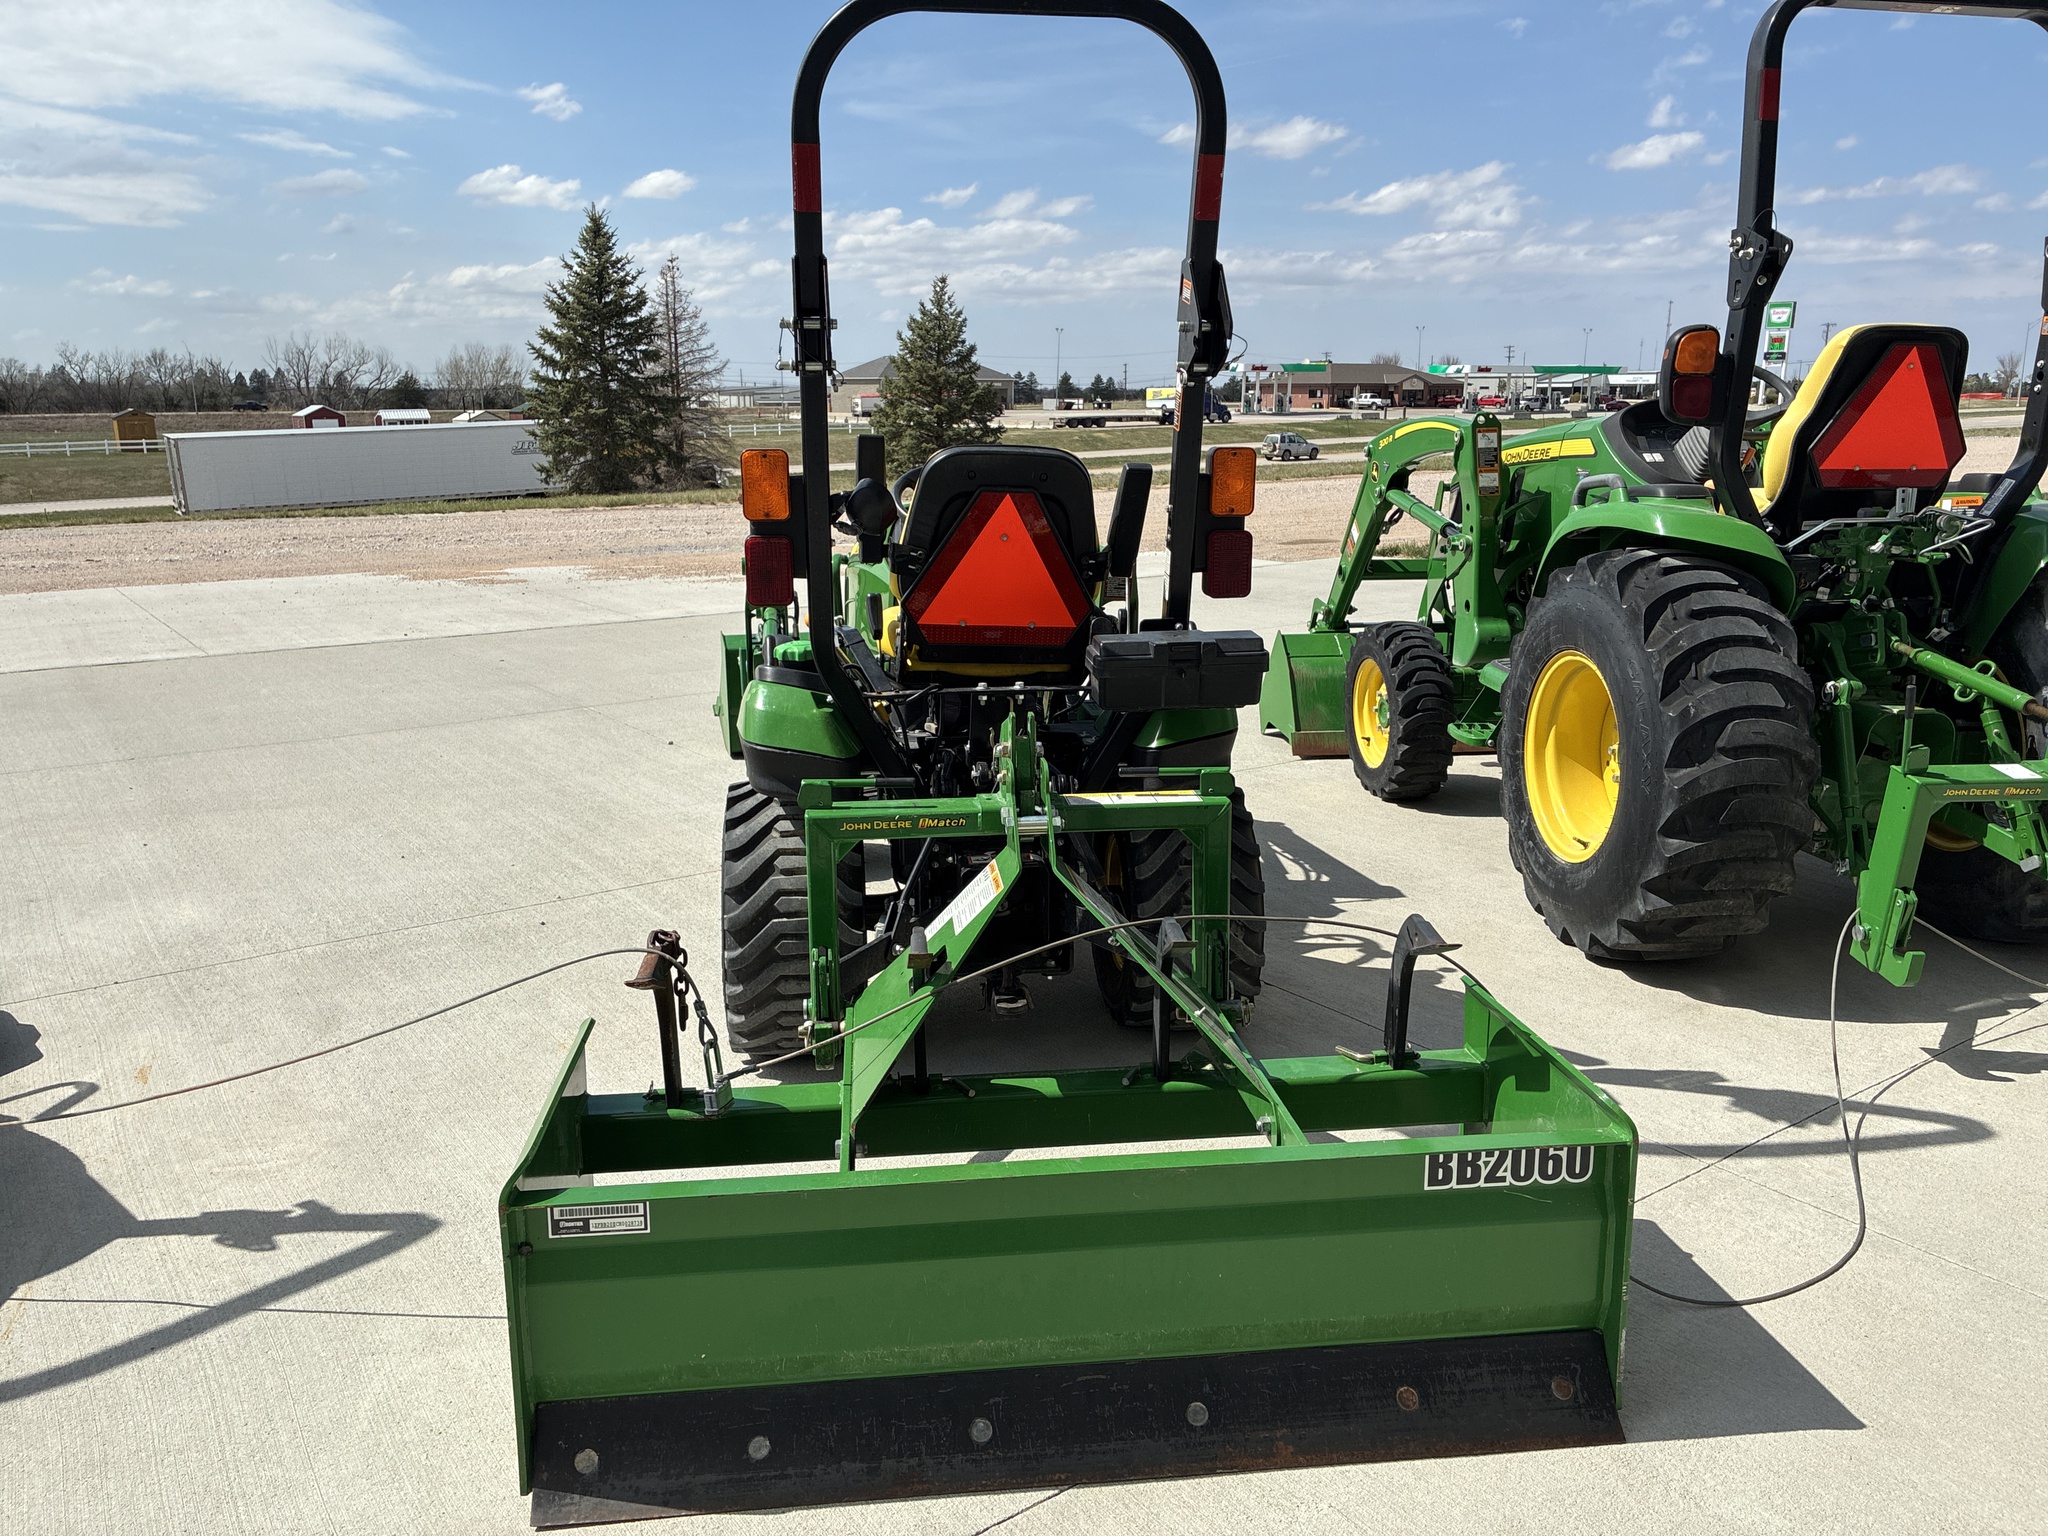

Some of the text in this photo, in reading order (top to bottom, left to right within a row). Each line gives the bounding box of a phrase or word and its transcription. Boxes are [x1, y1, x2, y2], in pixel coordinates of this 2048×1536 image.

[1503, 452, 1523, 463] JOHN
[1522, 448, 1552, 460] DEERE
[1943, 788, 1968, 796] JOHN
[1969, 788, 2000, 796] DEERE
[840, 822, 871, 831] JOHN
[873, 820, 913, 830] DEERE
[1424, 1146, 1595, 1190] BB2060
